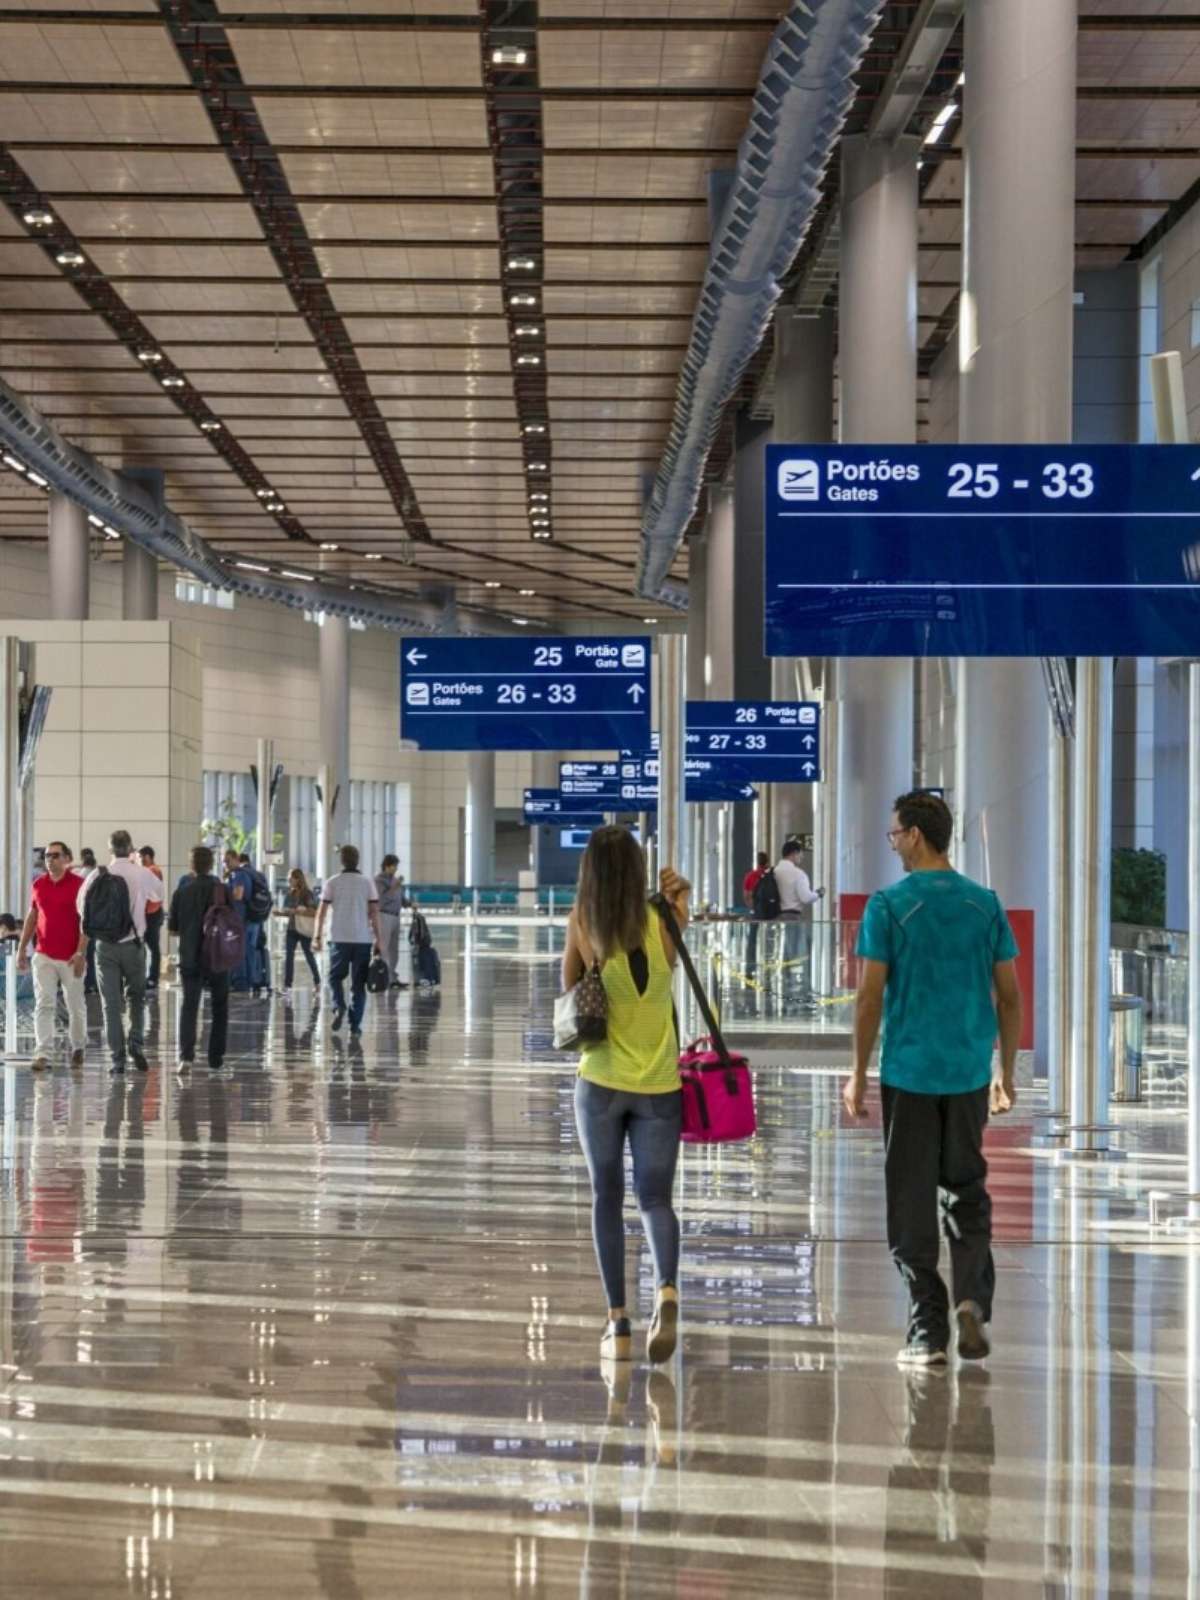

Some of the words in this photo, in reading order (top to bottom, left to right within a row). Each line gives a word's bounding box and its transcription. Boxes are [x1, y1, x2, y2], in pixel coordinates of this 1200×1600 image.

[827, 459, 920, 481] Portões
[947, 462, 999, 498] 25
[1013, 480, 1029, 488] -
[1041, 462, 1095, 498] 33
[827, 486, 879, 502] Gates
[533, 646, 563, 667] 25
[575, 645, 619, 657] Portão
[595, 658, 619, 668] Gate
[433, 683, 484, 695] Portões
[497, 684, 526, 704] 26
[547, 684, 577, 704] 33
[433, 697, 462, 707] Gates
[735, 708, 758, 724] 26
[765, 707, 797, 717] Portão
[779, 716, 797, 725] Gate
[708, 734, 731, 749] 27
[745, 734, 767, 749] 33
